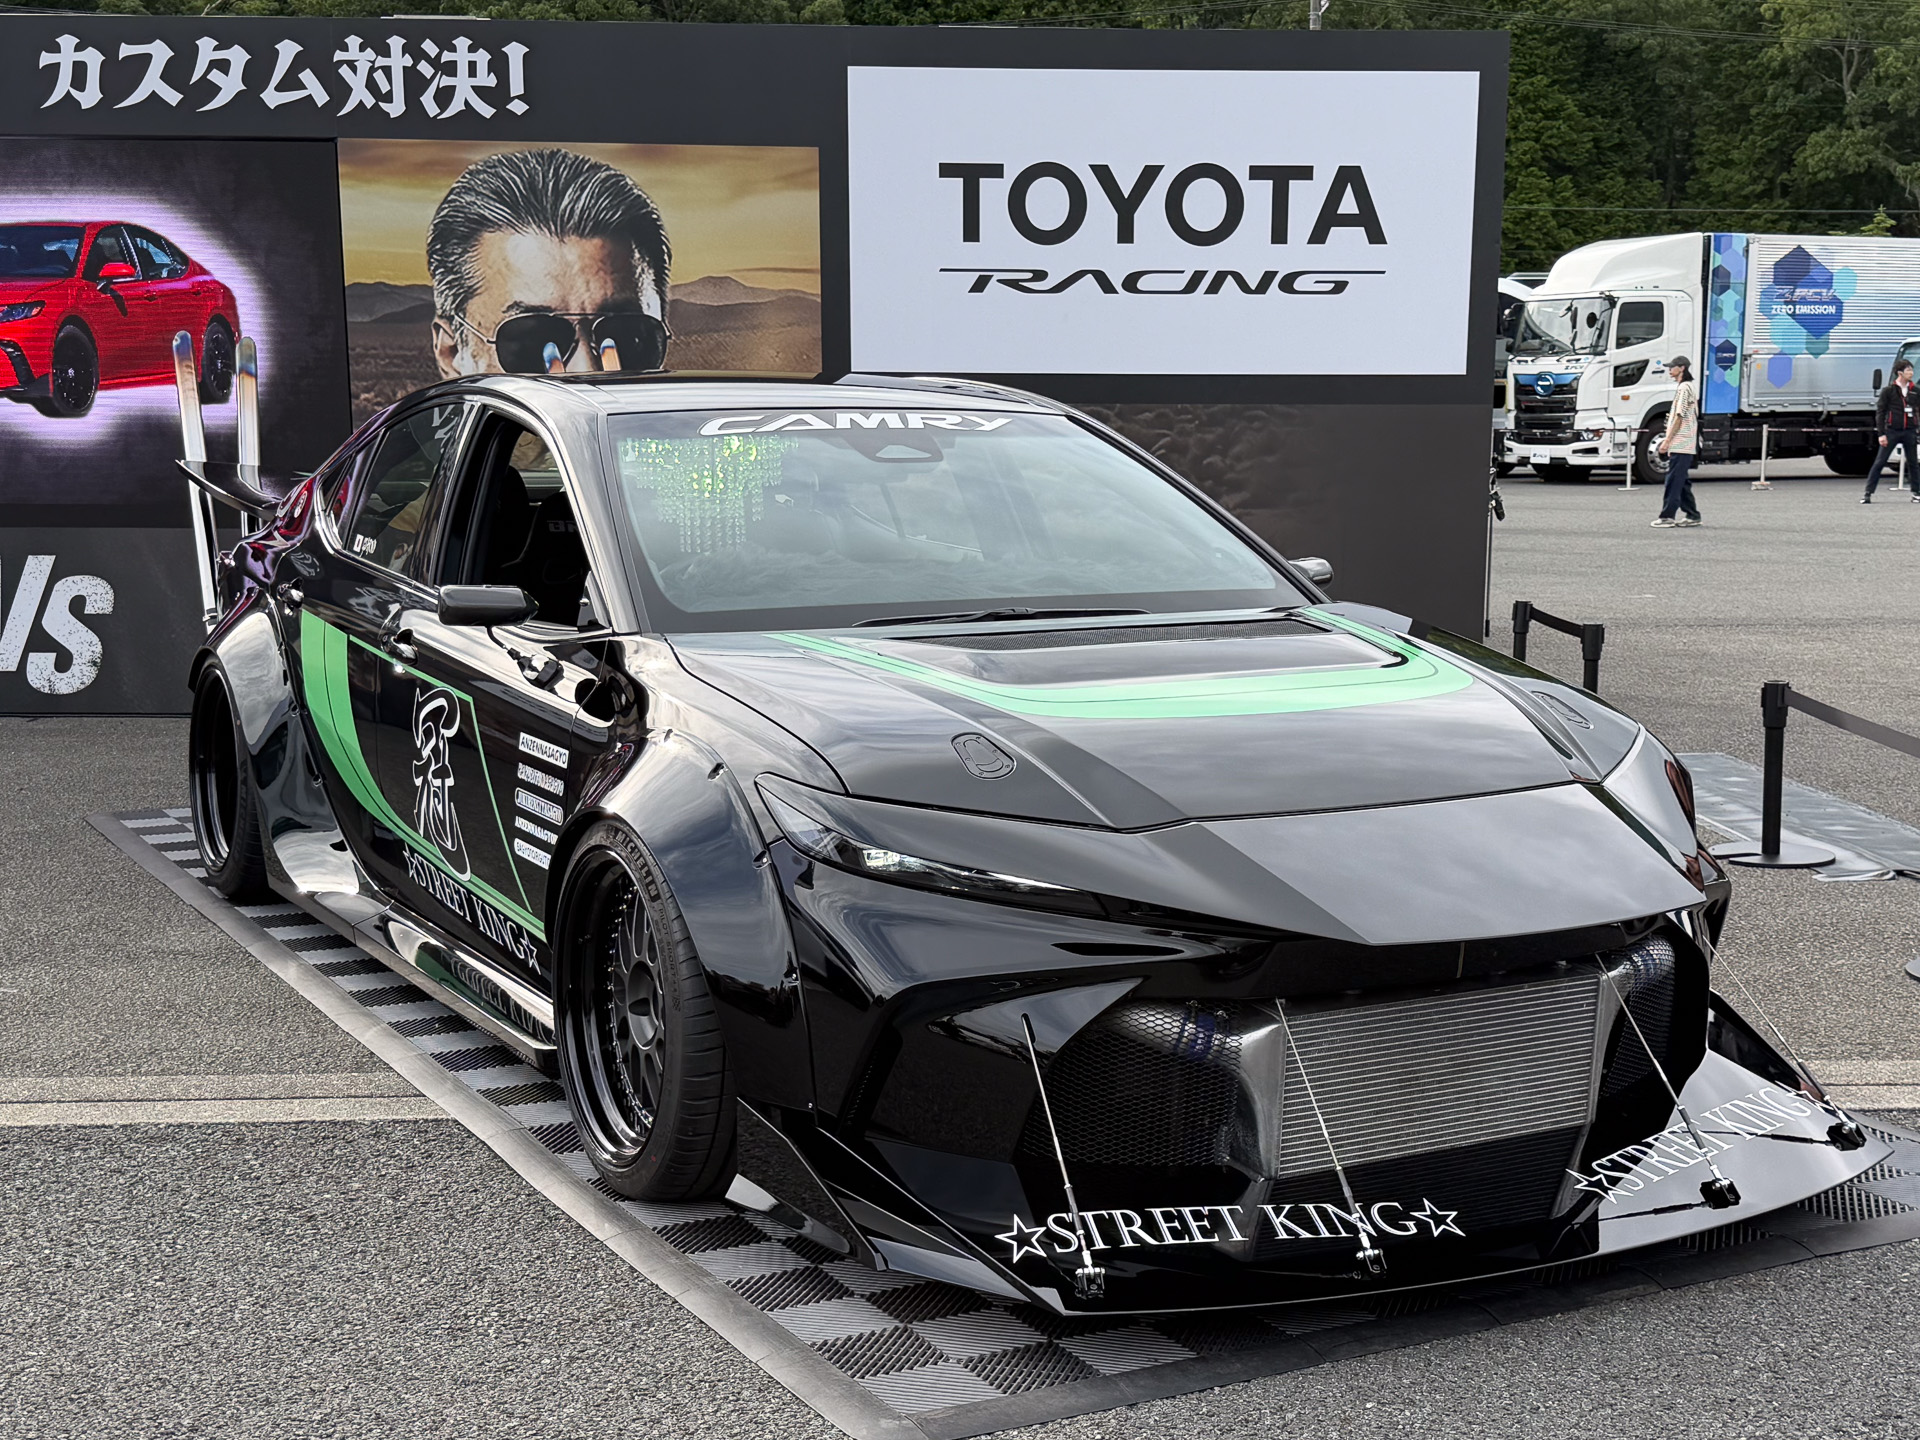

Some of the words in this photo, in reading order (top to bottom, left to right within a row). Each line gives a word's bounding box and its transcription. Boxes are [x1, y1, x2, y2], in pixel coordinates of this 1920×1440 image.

[38, 34, 531, 119] カスタム対決!
[939, 161, 1388, 247] TOYOTA
[939, 268, 1386, 295] RACING
[1771, 305, 1794, 314] ZERO
[1796, 305, 1836, 315] EMISSION
[698, 412, 1013, 436] CAMRY
[521, 736, 567, 765] ANZENNASAGYO
[616, 831, 658, 897] MICHELIN
[414, 853, 472, 923] STREET
[471, 894, 525, 959] KING
[659, 908, 669, 935] PILOT
[1592, 1119, 1734, 1191] STREET
[1700, 1087, 1812, 1140] KING
[1046, 1205, 1249, 1253] STREET
[1258, 1201, 1418, 1240] KING
